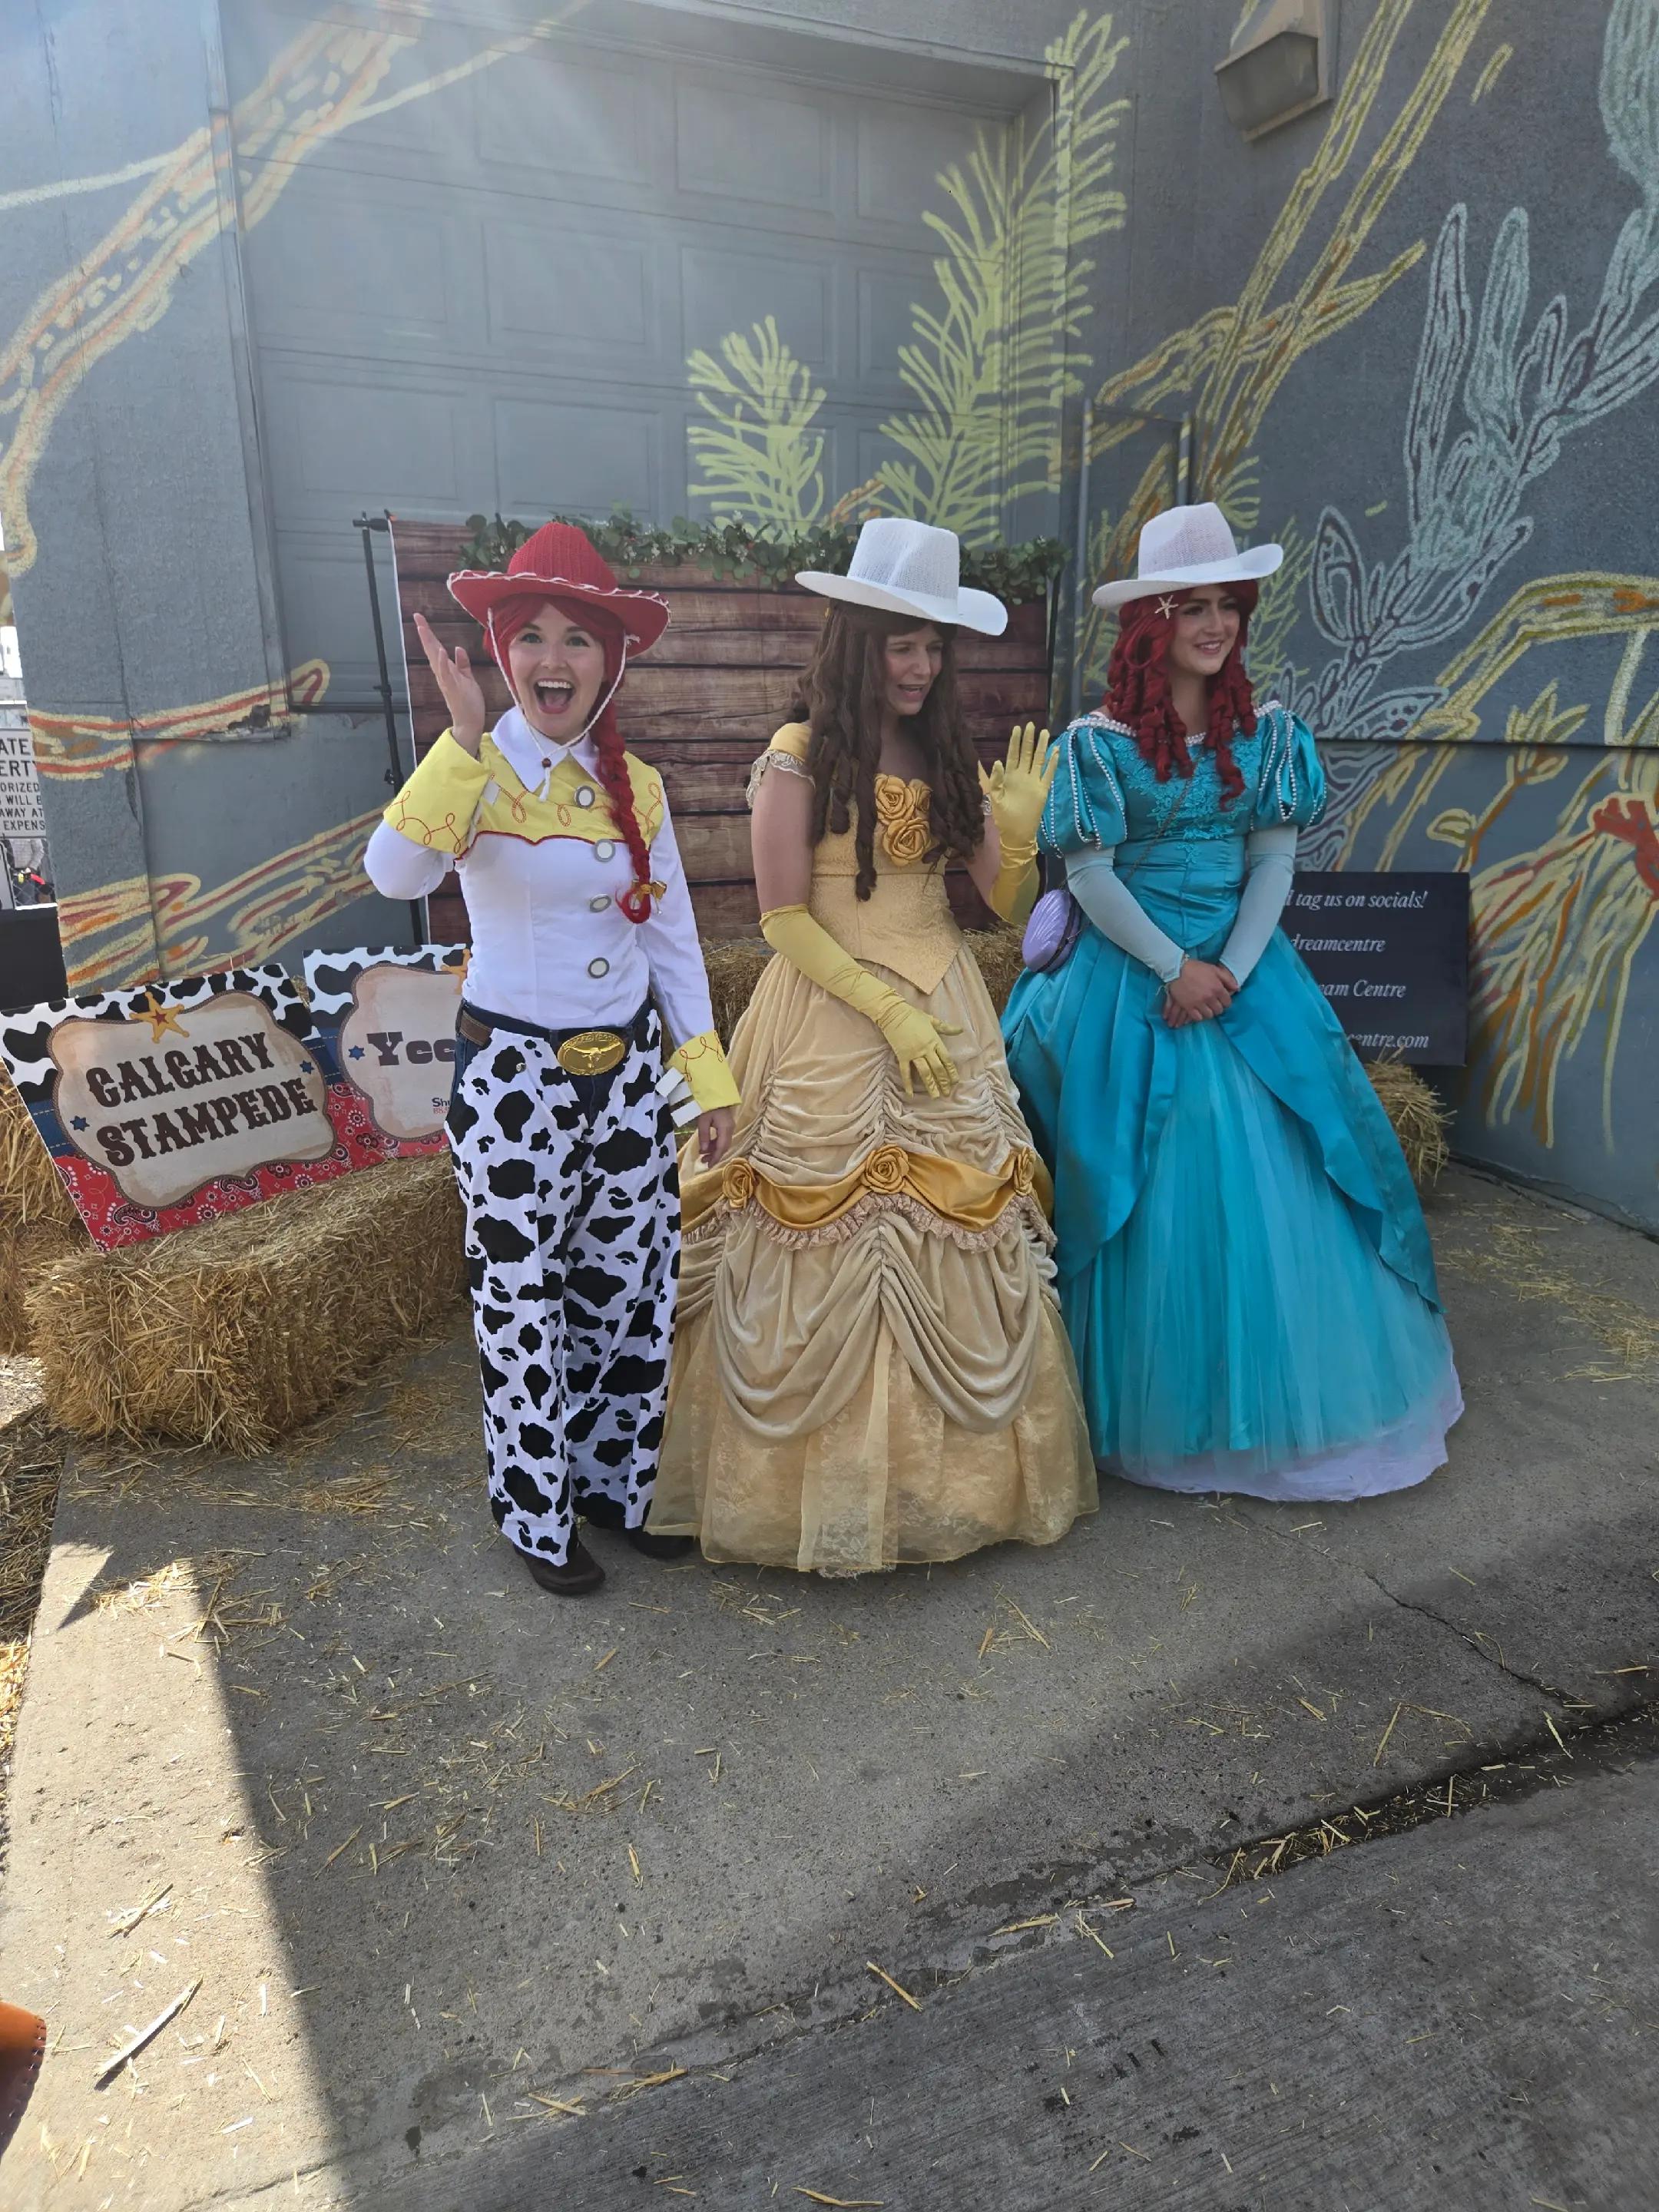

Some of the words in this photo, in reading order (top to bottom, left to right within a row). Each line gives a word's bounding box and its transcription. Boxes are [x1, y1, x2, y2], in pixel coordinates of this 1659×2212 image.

[0, 760, 35, 777] ERT
[5, 794, 32, 805] WILL
[32, 807, 43, 817] AT
[1295, 893, 1323, 911] tag
[1323, 895, 1343, 907] us
[1345, 895, 1366, 907] on
[1367, 890, 1429, 908] socials!
[1353, 979, 1406, 998] Centre
[85, 1031, 275, 1108] CALGARY
[96, 1078, 318, 1167] STAMPEDE
